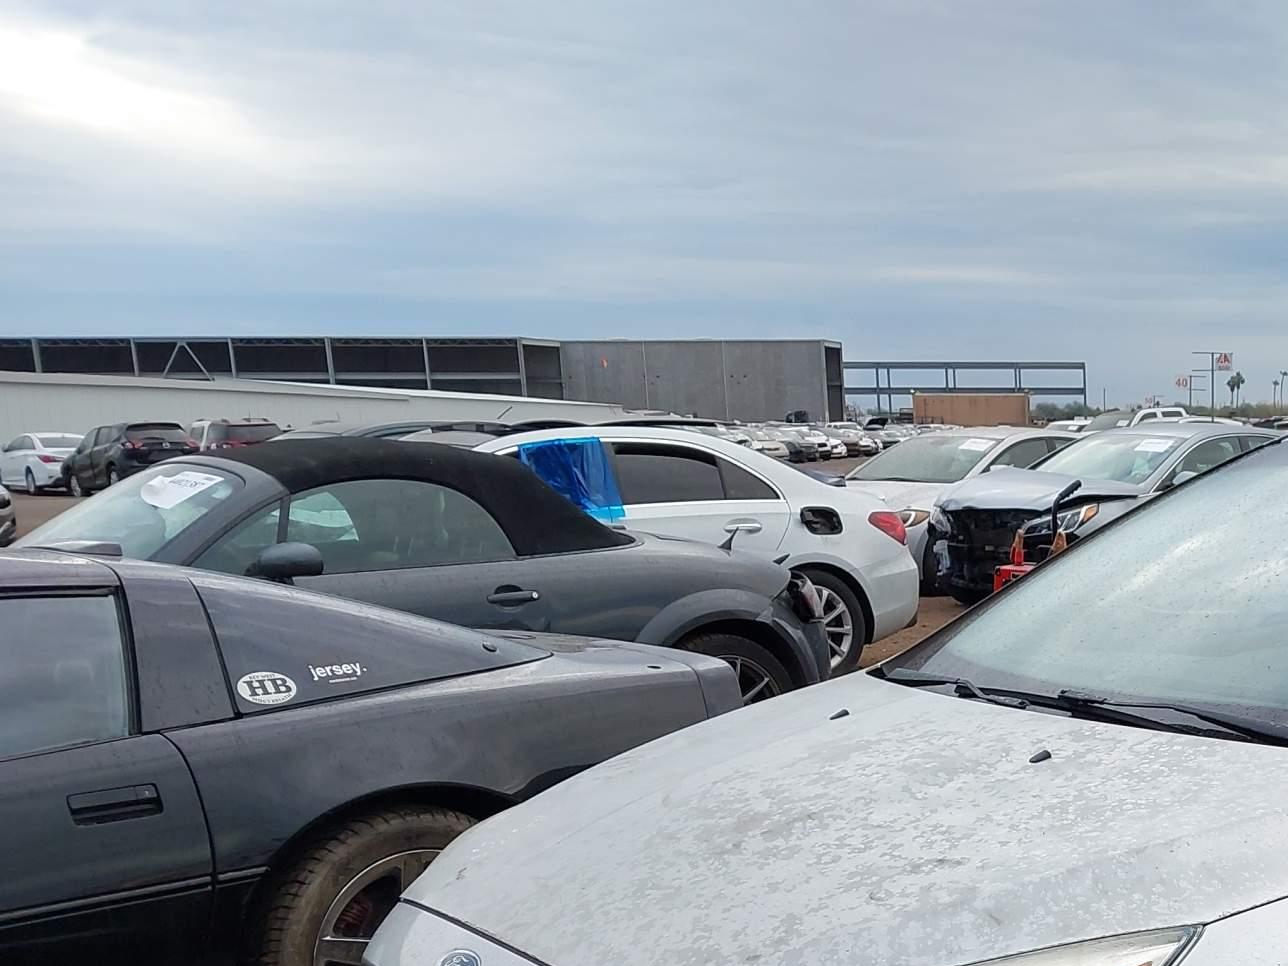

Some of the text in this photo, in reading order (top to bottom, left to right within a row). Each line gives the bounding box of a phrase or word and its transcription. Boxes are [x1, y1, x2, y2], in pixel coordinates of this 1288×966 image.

[1175, 378, 1188, 387] 40
[308, 662, 368, 681] jersey.
[242, 677, 293, 697] HB
